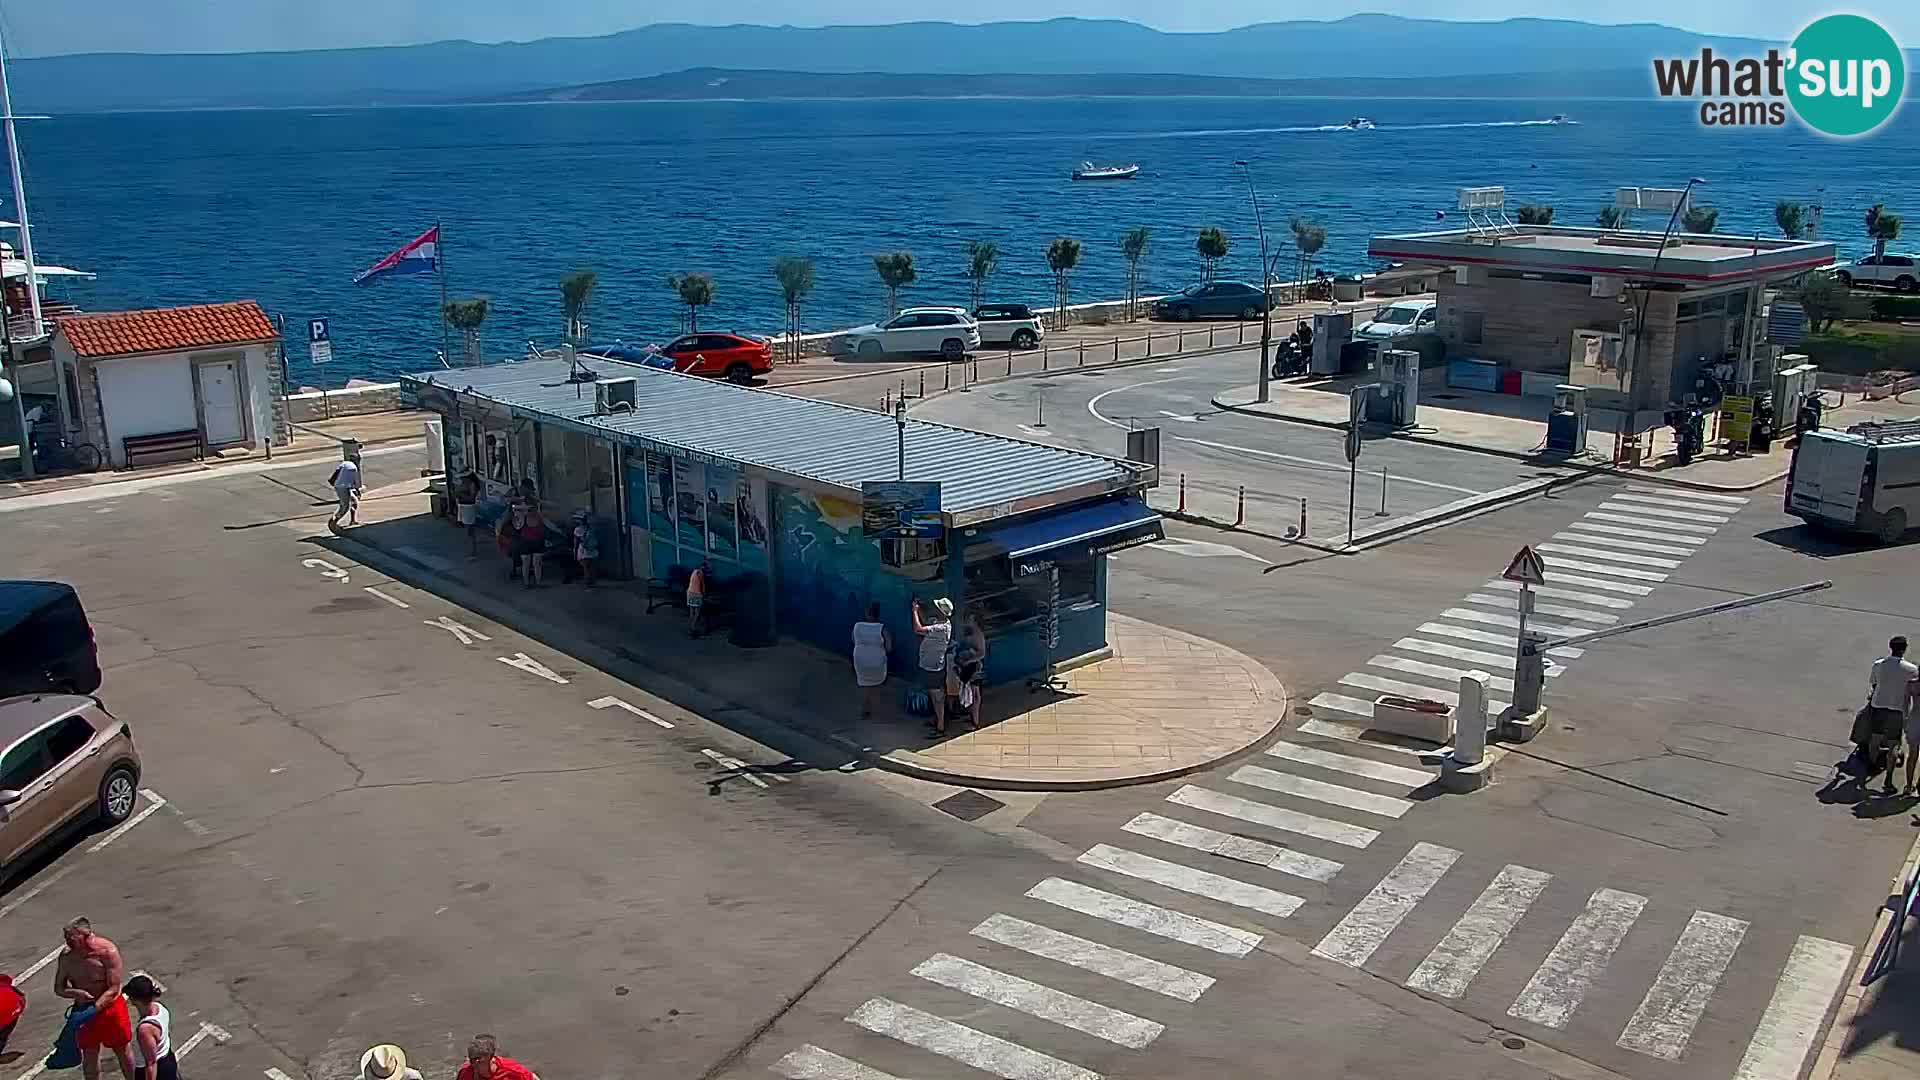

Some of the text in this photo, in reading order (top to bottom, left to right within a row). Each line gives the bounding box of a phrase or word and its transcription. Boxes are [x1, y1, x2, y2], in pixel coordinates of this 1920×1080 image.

[312, 321, 325, 340] P
[655, 444, 687, 459] STATION
[688, 451, 714, 465] TICKET
[714, 457, 742, 472] OFFICE
